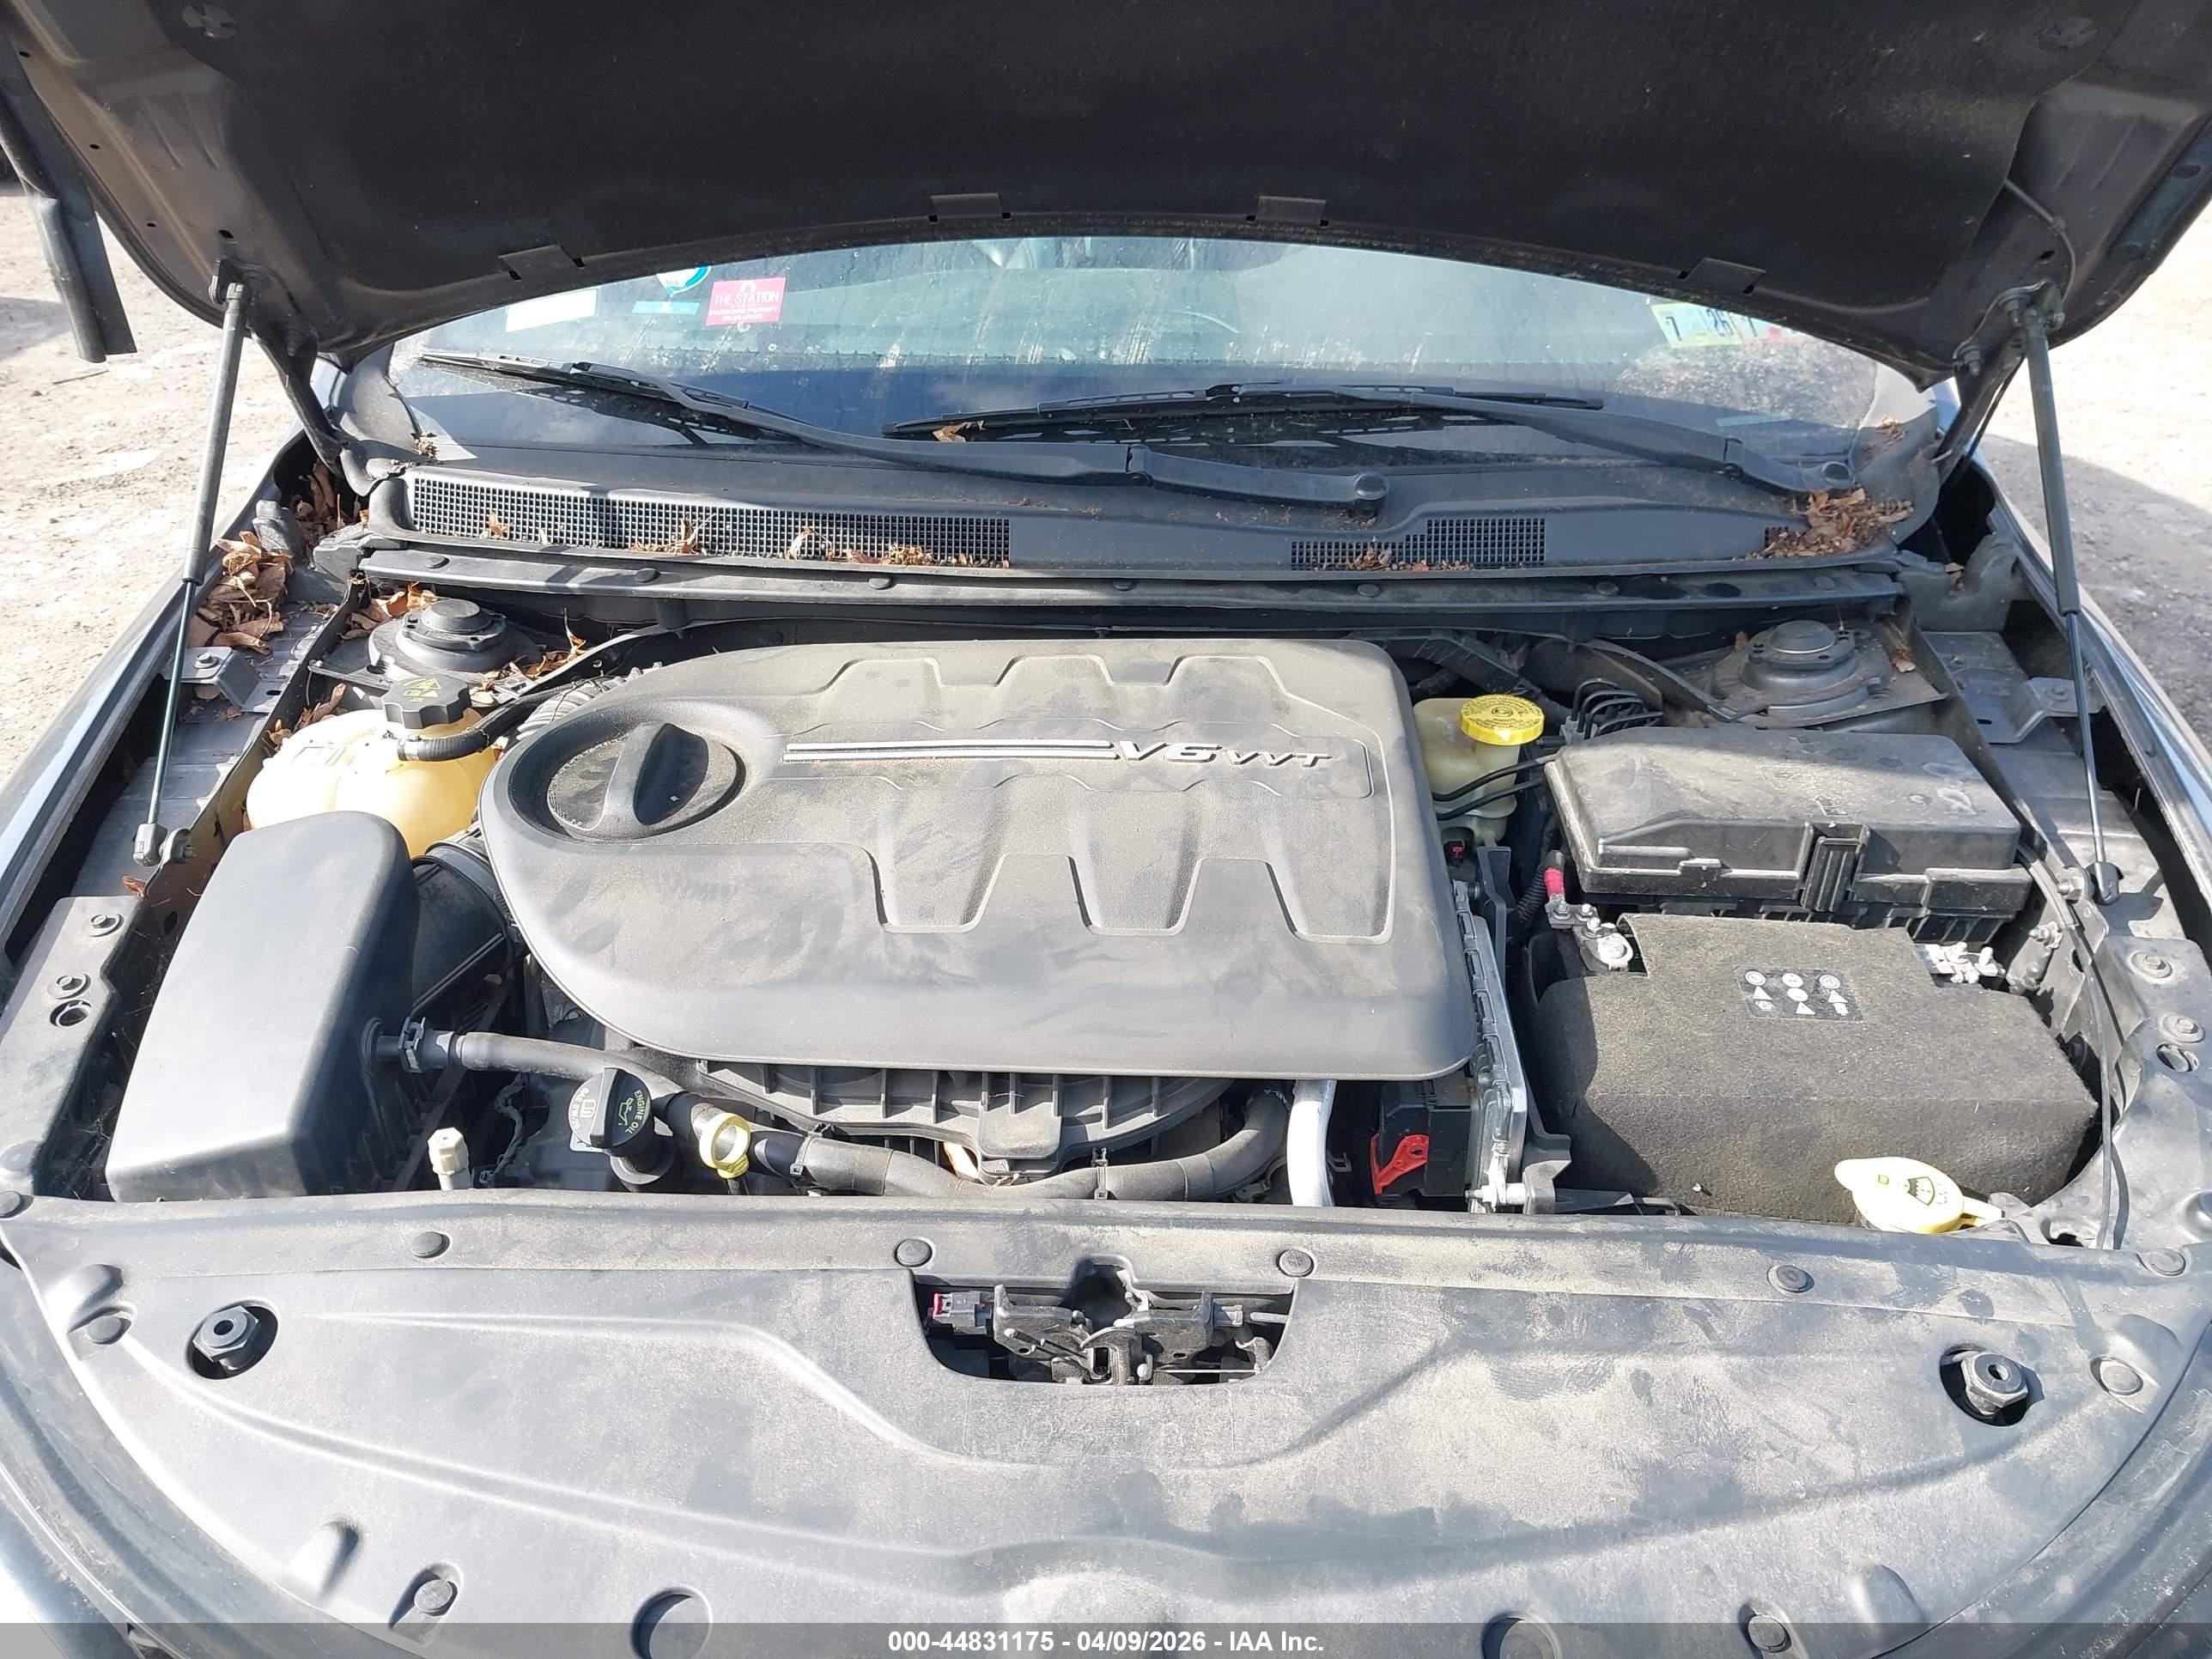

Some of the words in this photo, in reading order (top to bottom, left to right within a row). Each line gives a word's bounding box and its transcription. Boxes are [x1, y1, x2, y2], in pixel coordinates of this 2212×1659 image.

[714, 295, 732, 305] THE
[735, 291, 780, 303] STATION
[708, 308, 745, 317] PARKING
[747, 306, 777, 314] PERMIT
[1119, 740, 1223, 763] V6
[1227, 750, 1333, 767] VVT
[575, 1087, 589, 1103] SAE
[634, 1089, 645, 1121] ENGINE
[624, 1121, 639, 1133] OIL
